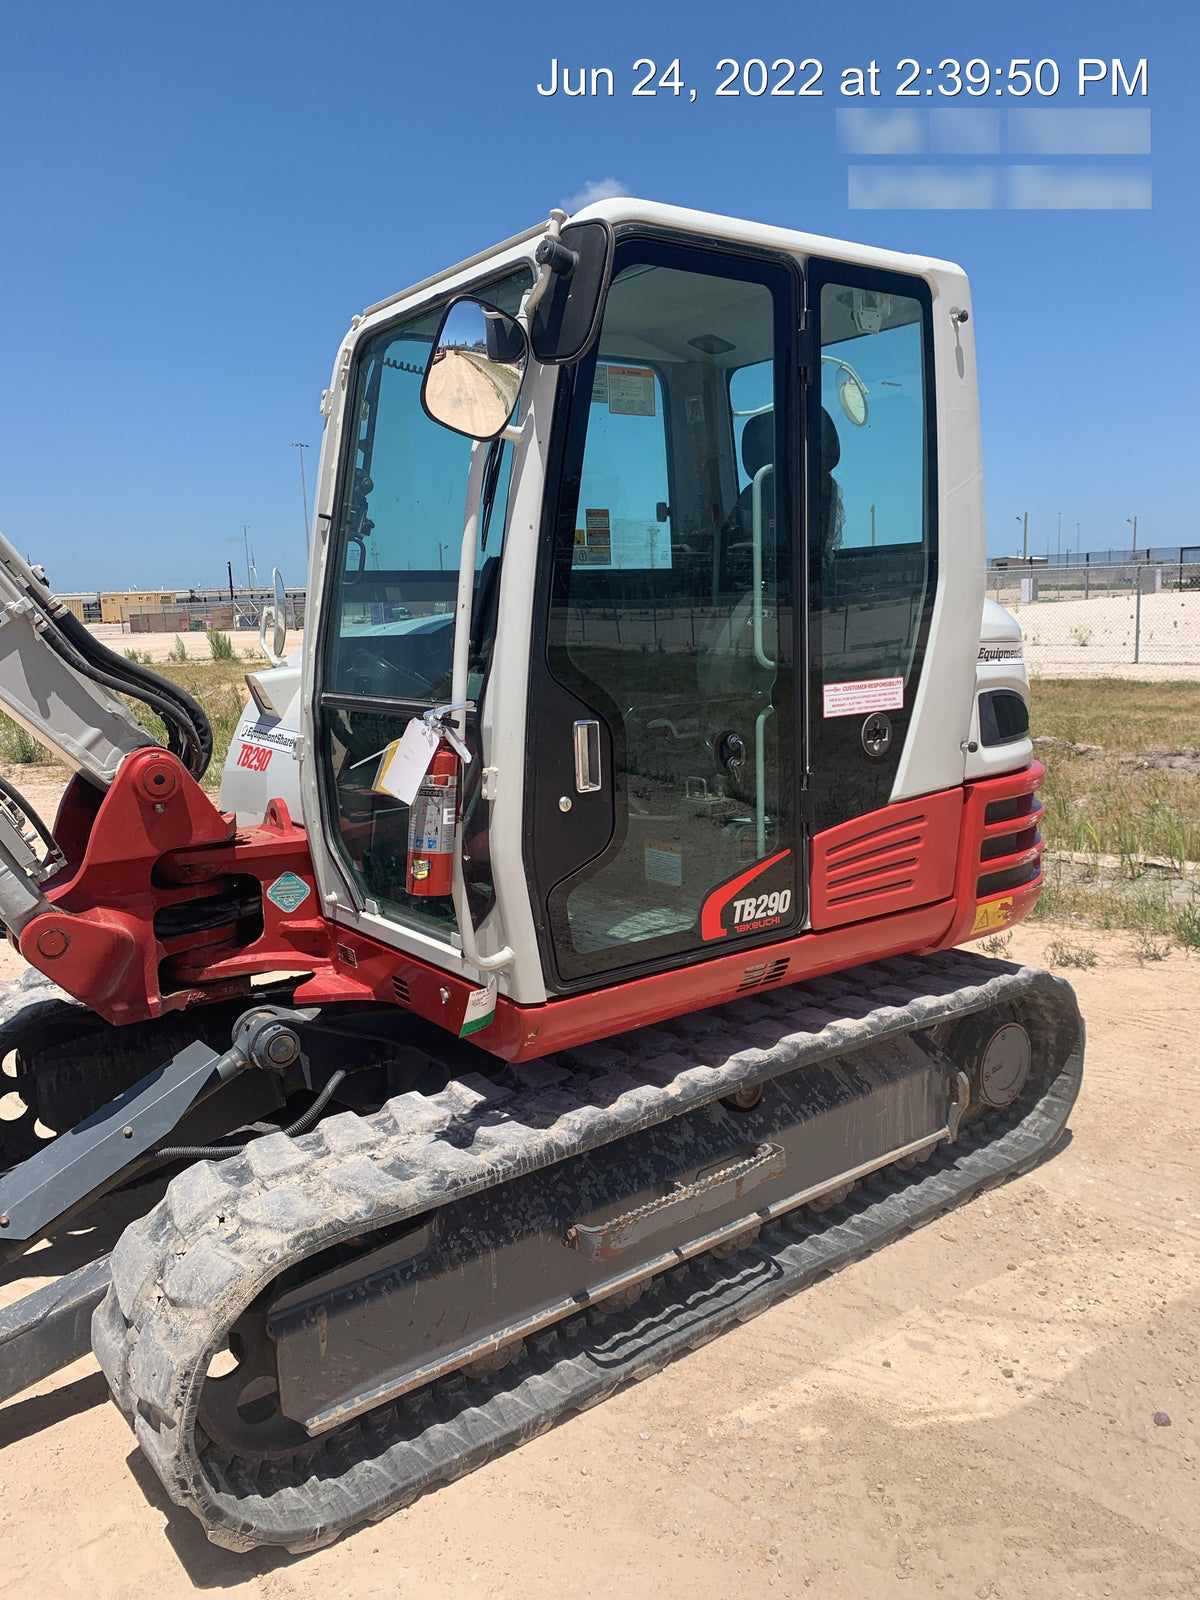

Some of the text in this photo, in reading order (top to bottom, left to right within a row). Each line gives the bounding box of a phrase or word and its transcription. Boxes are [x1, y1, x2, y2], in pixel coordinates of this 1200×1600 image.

[842, 684, 868, 692] CUSTOMER
[868, 680, 902, 689] RESPONSIBILITY
[236, 743, 273, 771] TB290
[733, 889, 791, 923] TB290
